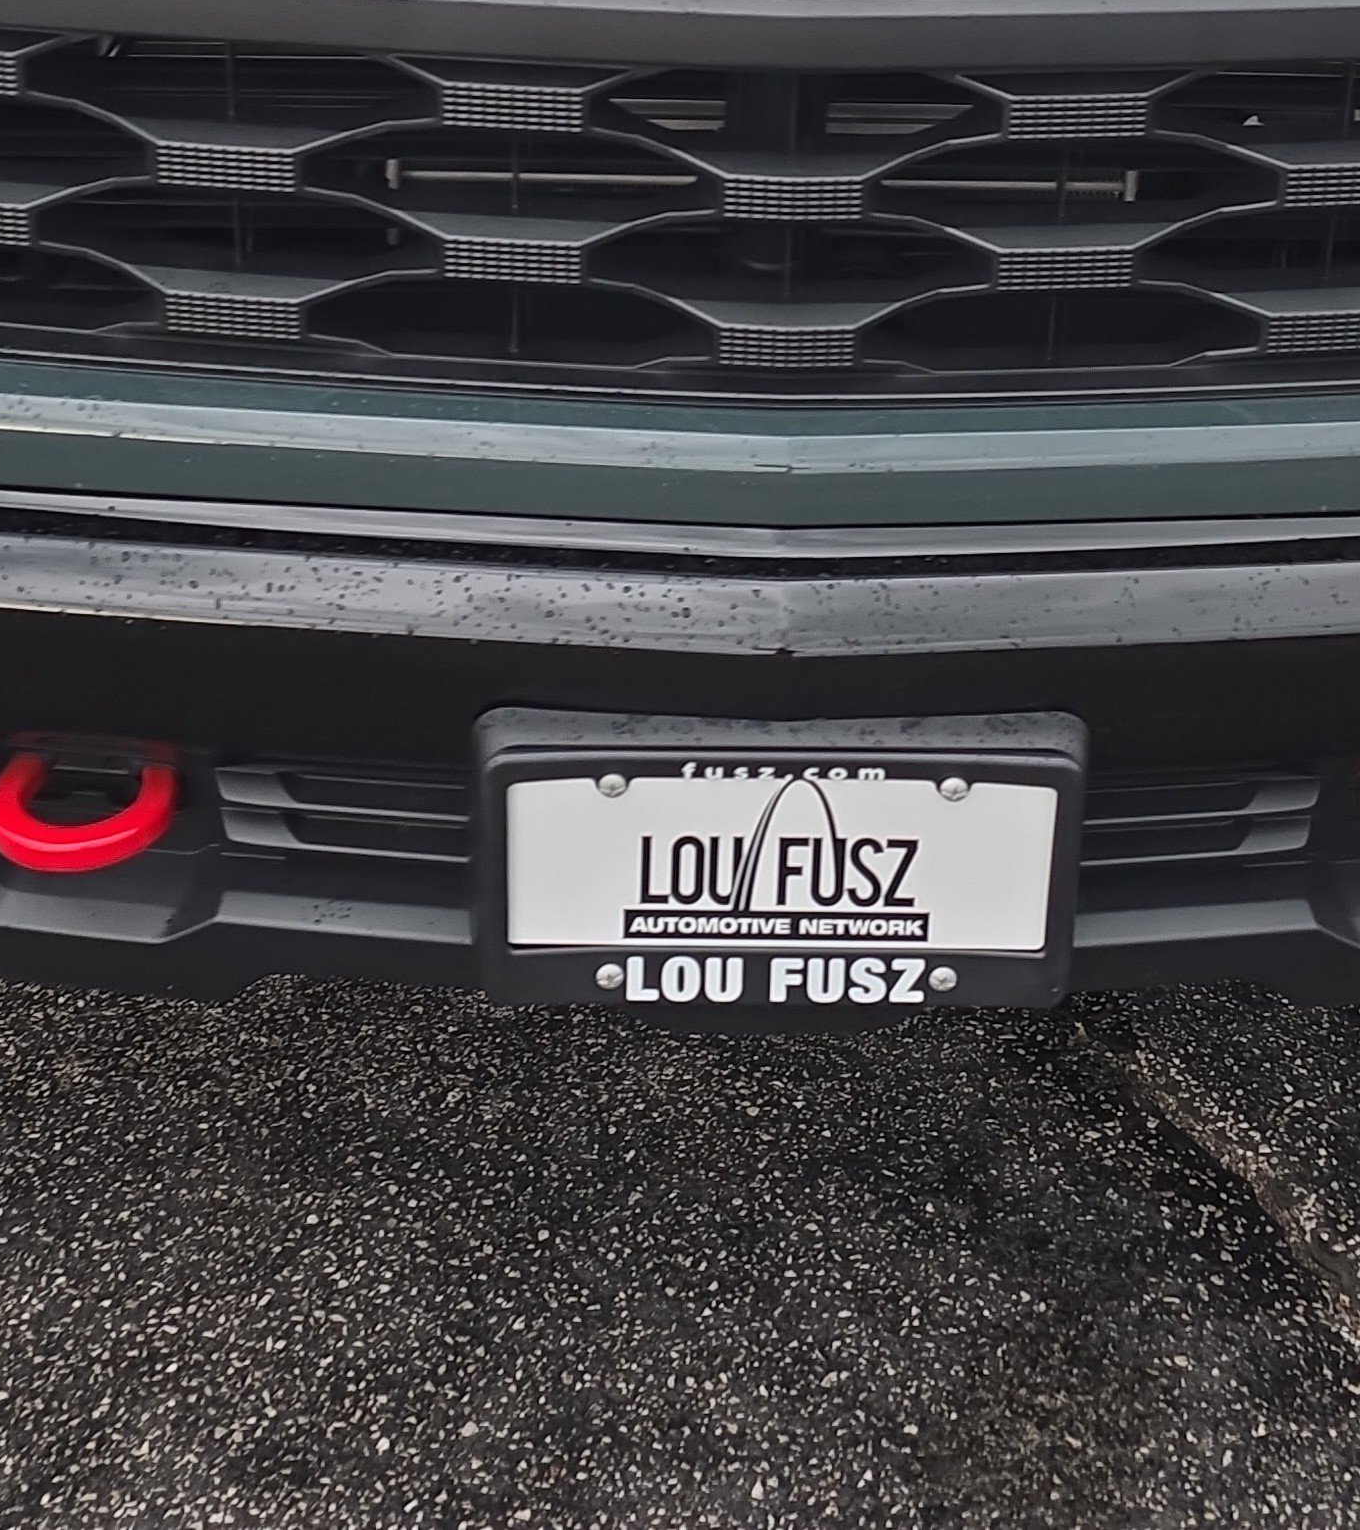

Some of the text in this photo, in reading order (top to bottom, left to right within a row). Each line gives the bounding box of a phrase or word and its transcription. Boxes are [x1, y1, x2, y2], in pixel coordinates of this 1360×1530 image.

[680, 761, 887, 781] fusz.com
[640, 835, 919, 907] LOU FUSZ
[629, 917, 924, 938] AUTOMOTIVE NETWORK
[626, 956, 926, 1003] LOU FUSZ
